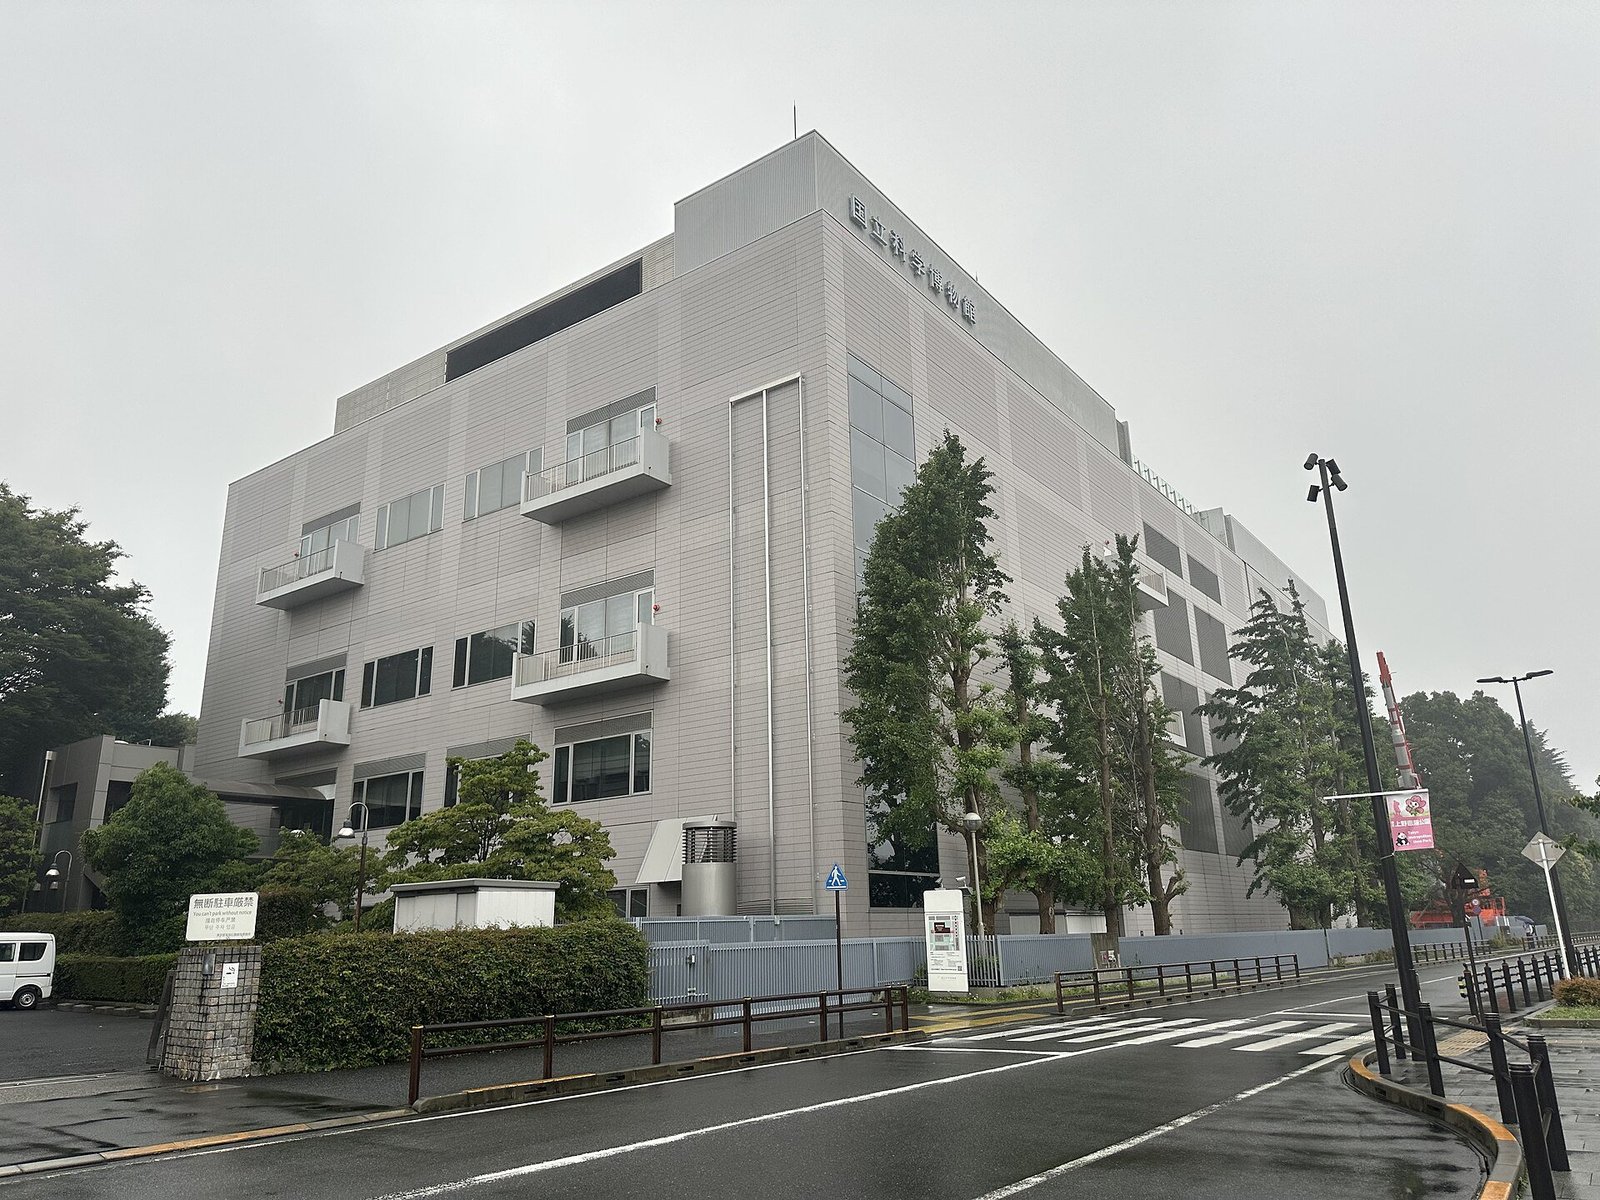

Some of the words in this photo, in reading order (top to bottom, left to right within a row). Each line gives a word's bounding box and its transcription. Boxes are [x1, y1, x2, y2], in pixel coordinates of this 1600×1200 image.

[849, 192, 977, 325] 国立科学博物館
[194, 897, 254, 908] 無断駐車厳禁
